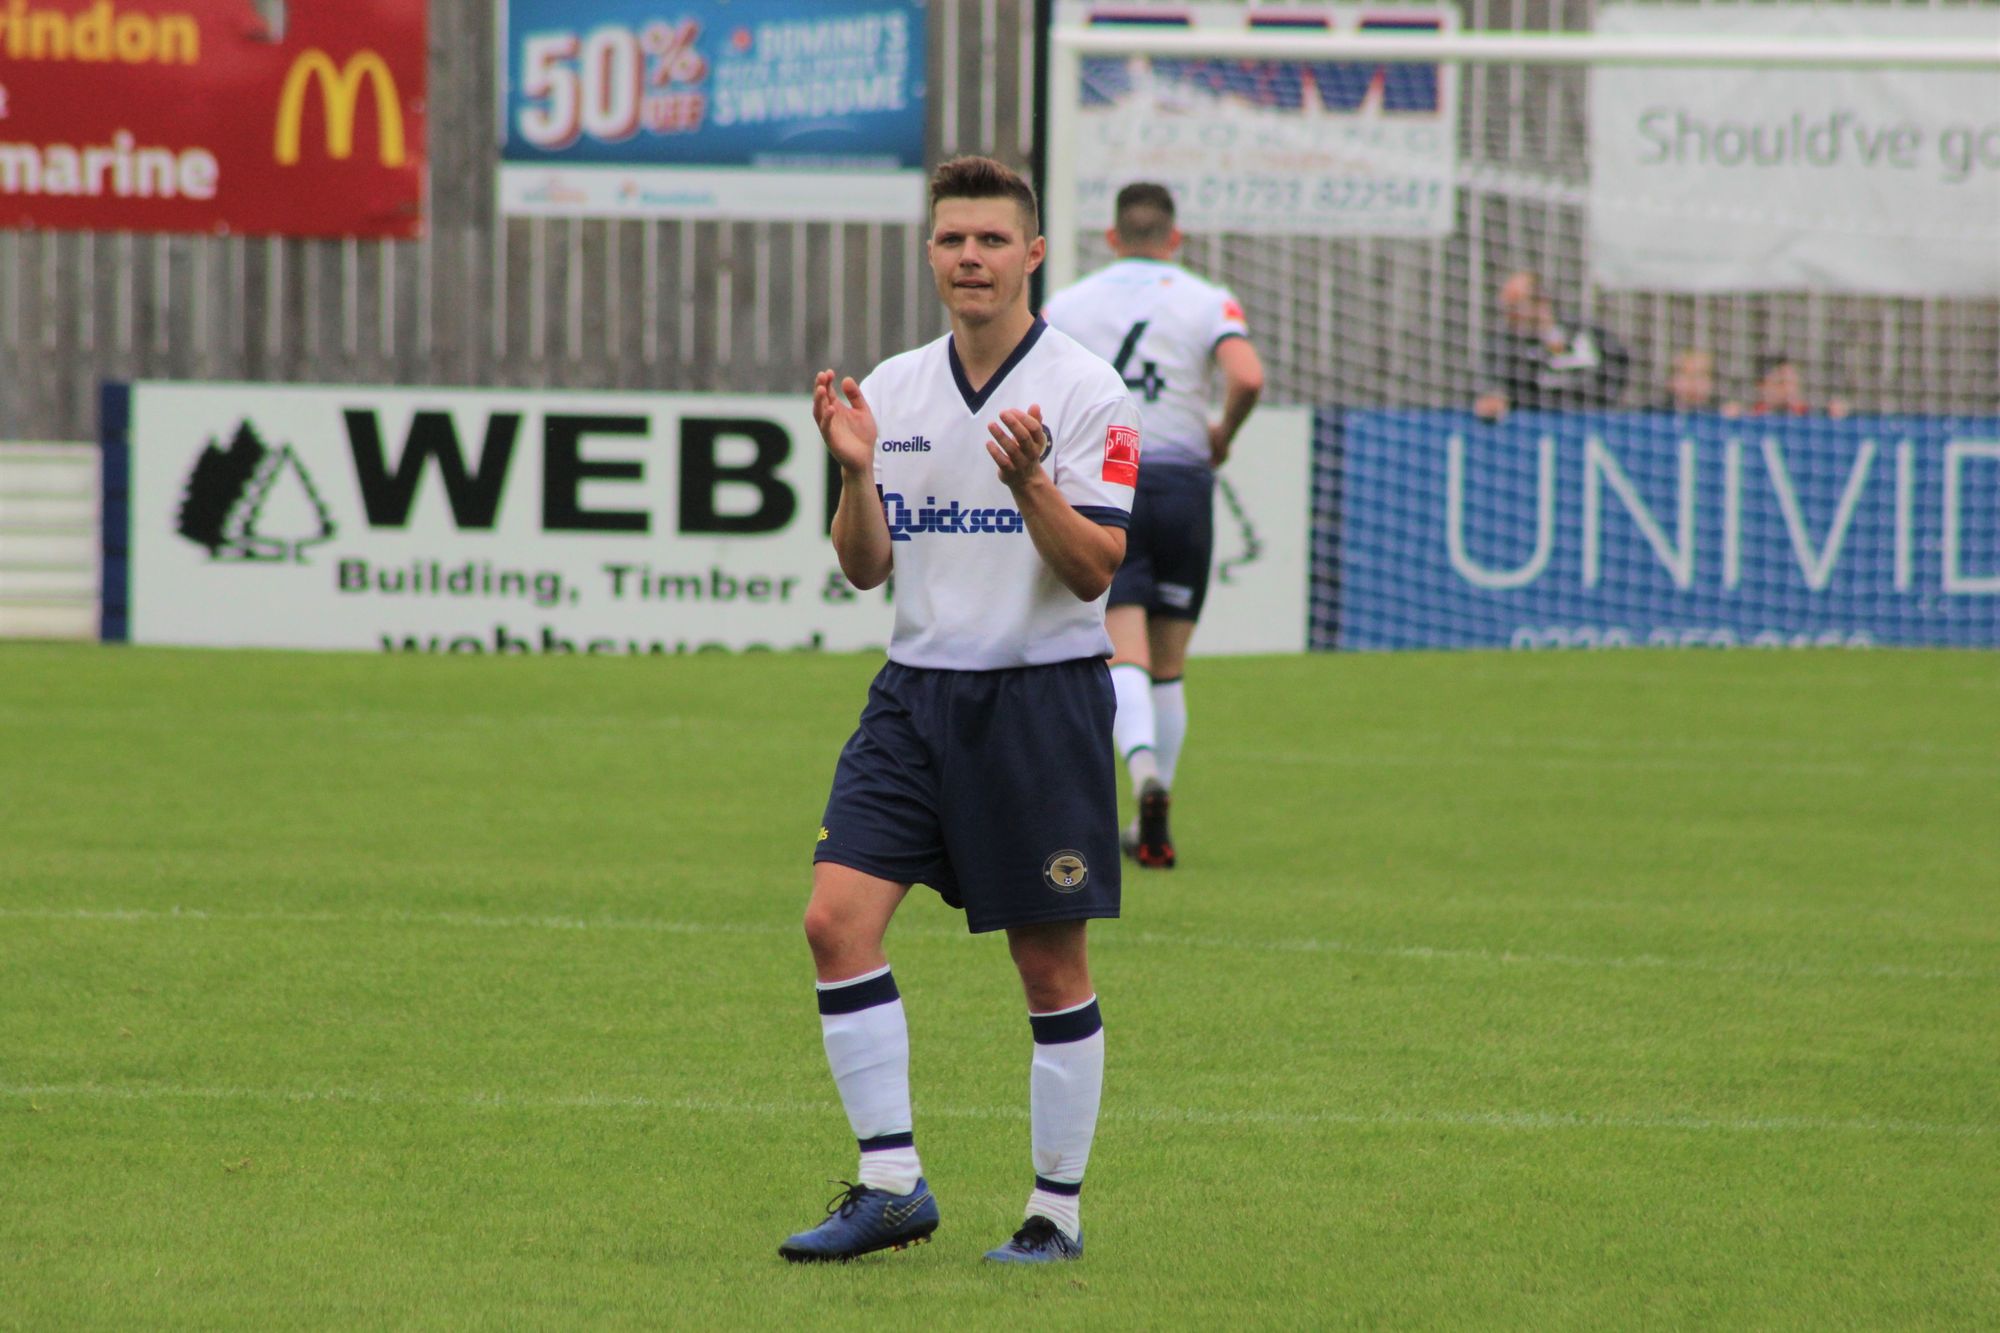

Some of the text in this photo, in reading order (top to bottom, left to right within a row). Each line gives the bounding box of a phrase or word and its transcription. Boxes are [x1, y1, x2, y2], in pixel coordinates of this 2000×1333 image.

[0, 0, 199, 65] indon
[1636, 107, 1922, 169] Should've
[342, 408, 842, 538] WEB
[337, 558, 582, 608] Building,
[602, 562, 799, 602] Timber
